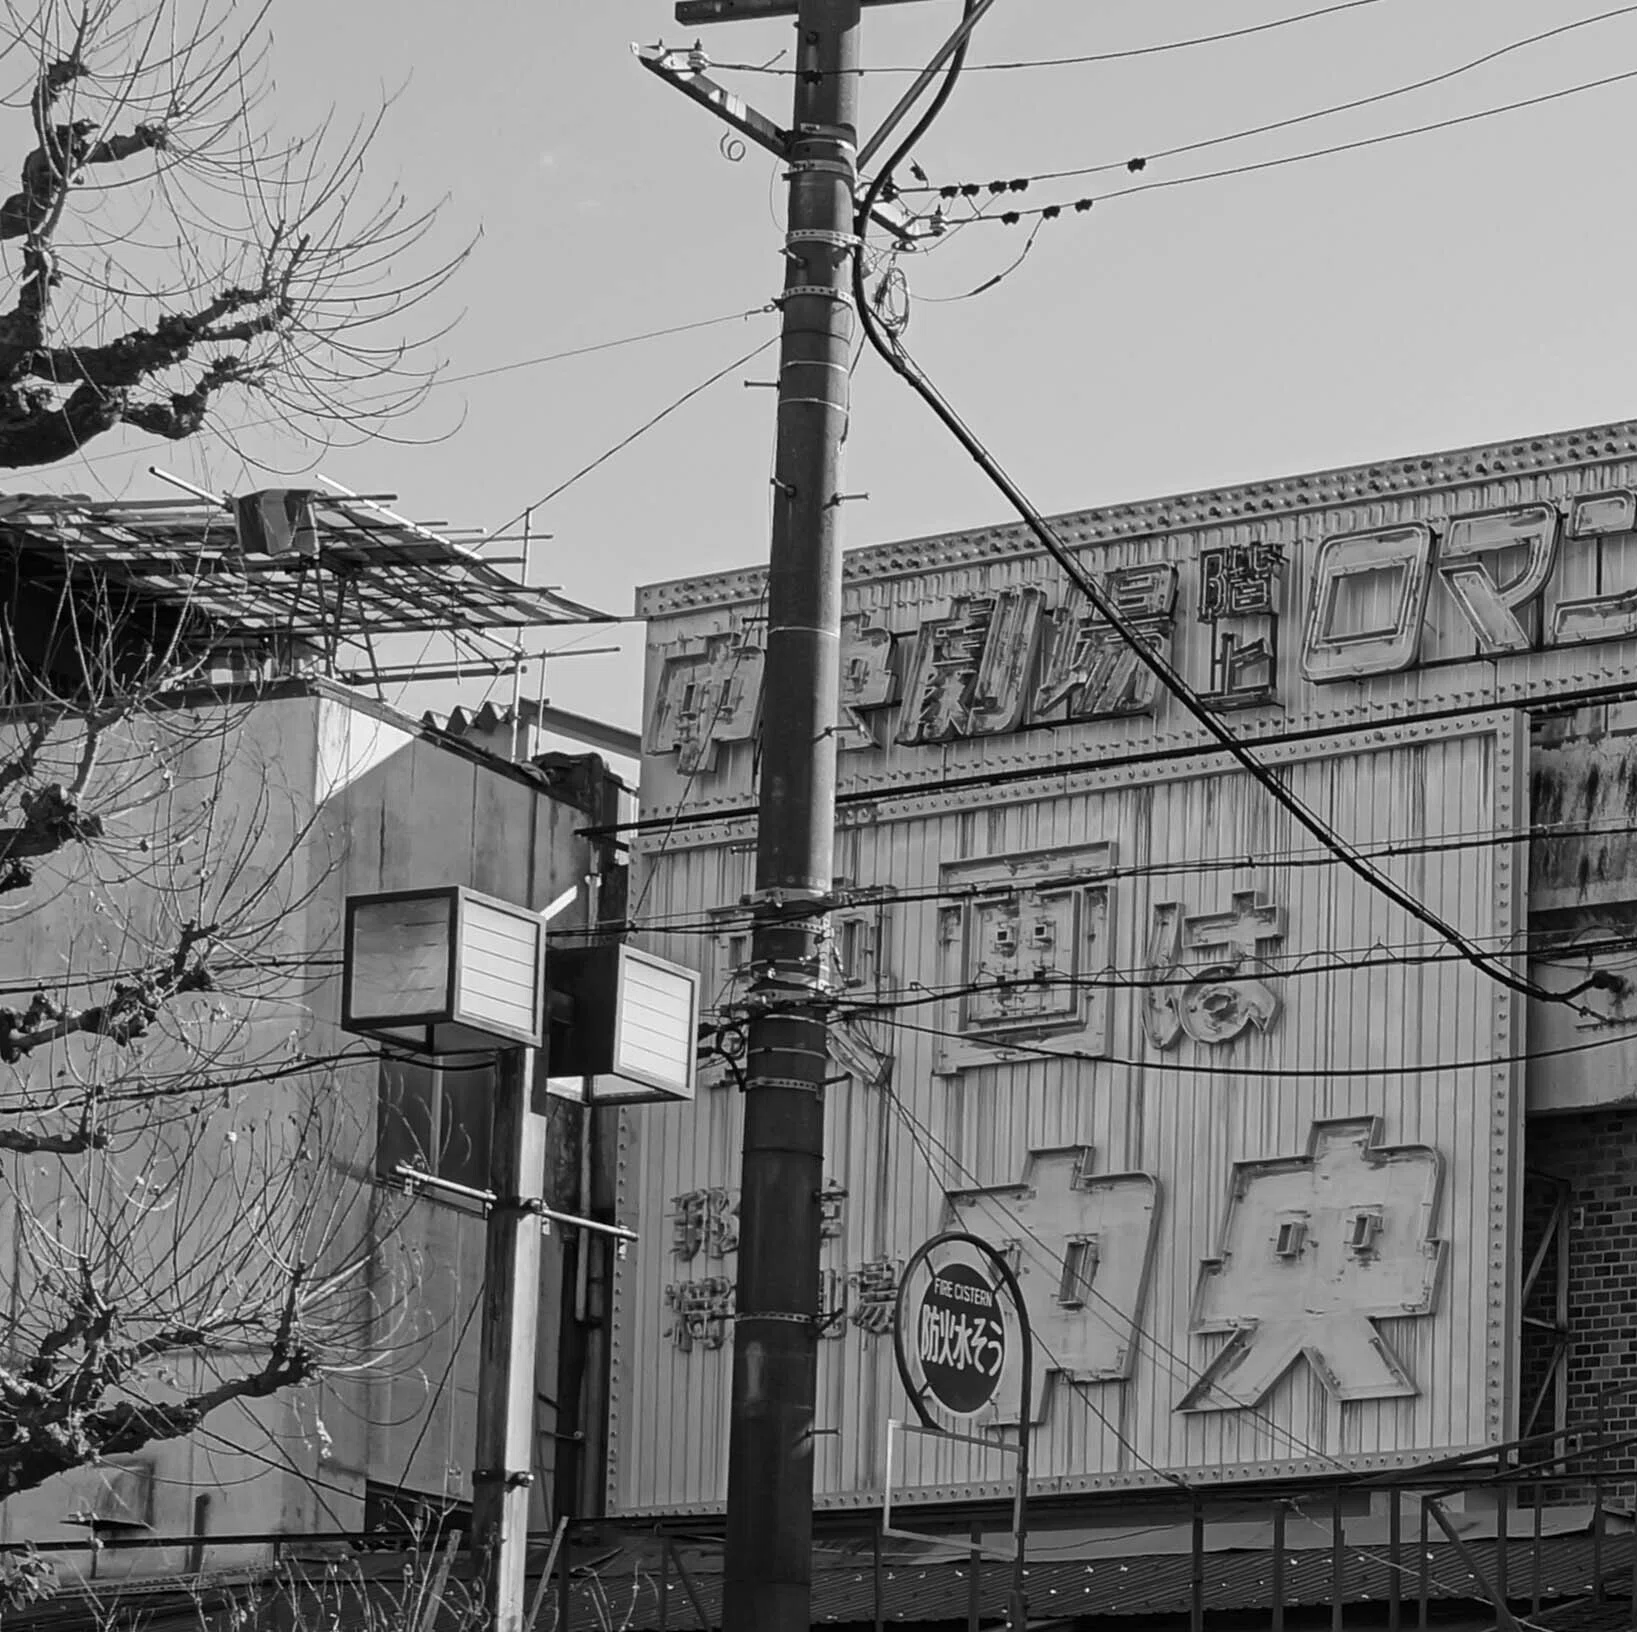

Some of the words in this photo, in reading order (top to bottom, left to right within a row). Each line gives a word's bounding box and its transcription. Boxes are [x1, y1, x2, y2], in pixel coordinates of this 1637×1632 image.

[934, 1277, 953, 1299] FIRE
[954, 1279, 993, 1308] CISTERN
[921, 1304, 1003, 1376] 防火水そう
